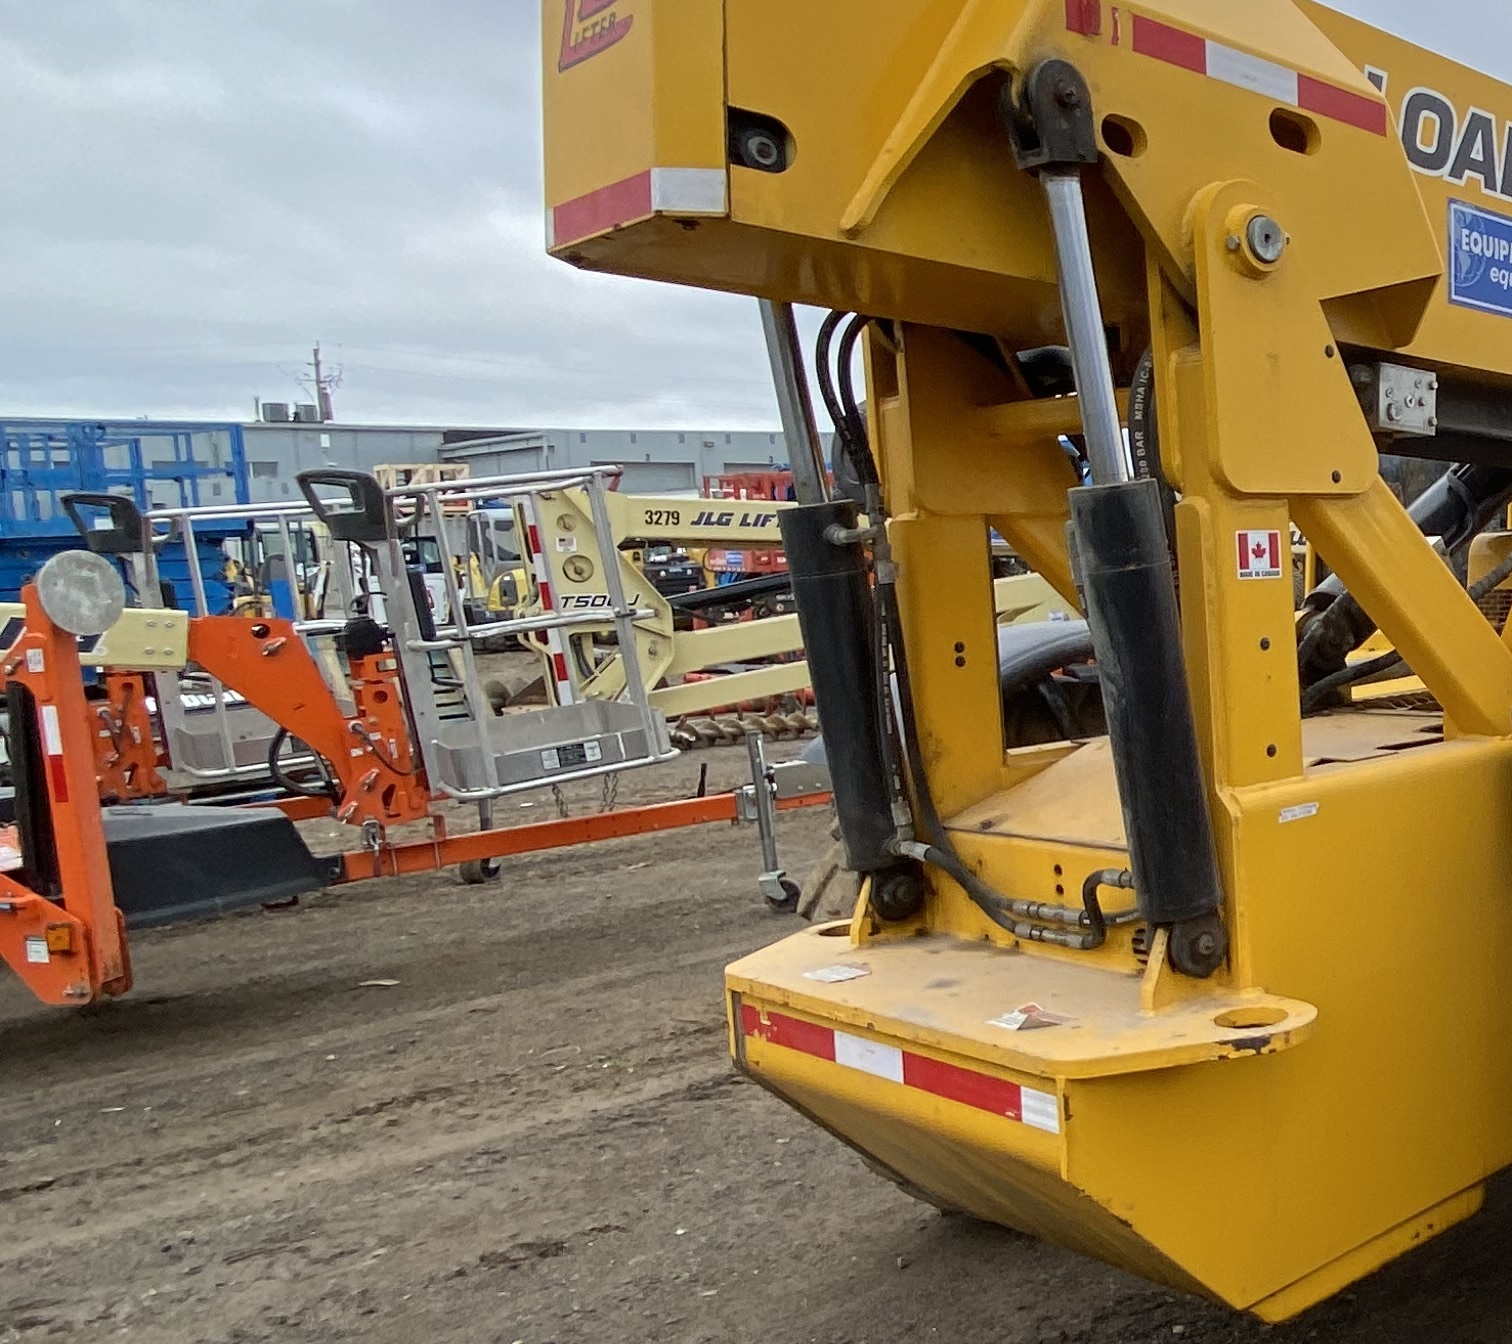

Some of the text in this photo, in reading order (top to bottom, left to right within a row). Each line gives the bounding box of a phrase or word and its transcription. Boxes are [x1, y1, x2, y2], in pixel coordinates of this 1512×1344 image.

[1134, 431, 1147, 457] BAR
[644, 510, 781, 528] 3279 JLG LIF
[560, 593, 640, 609] T50J
